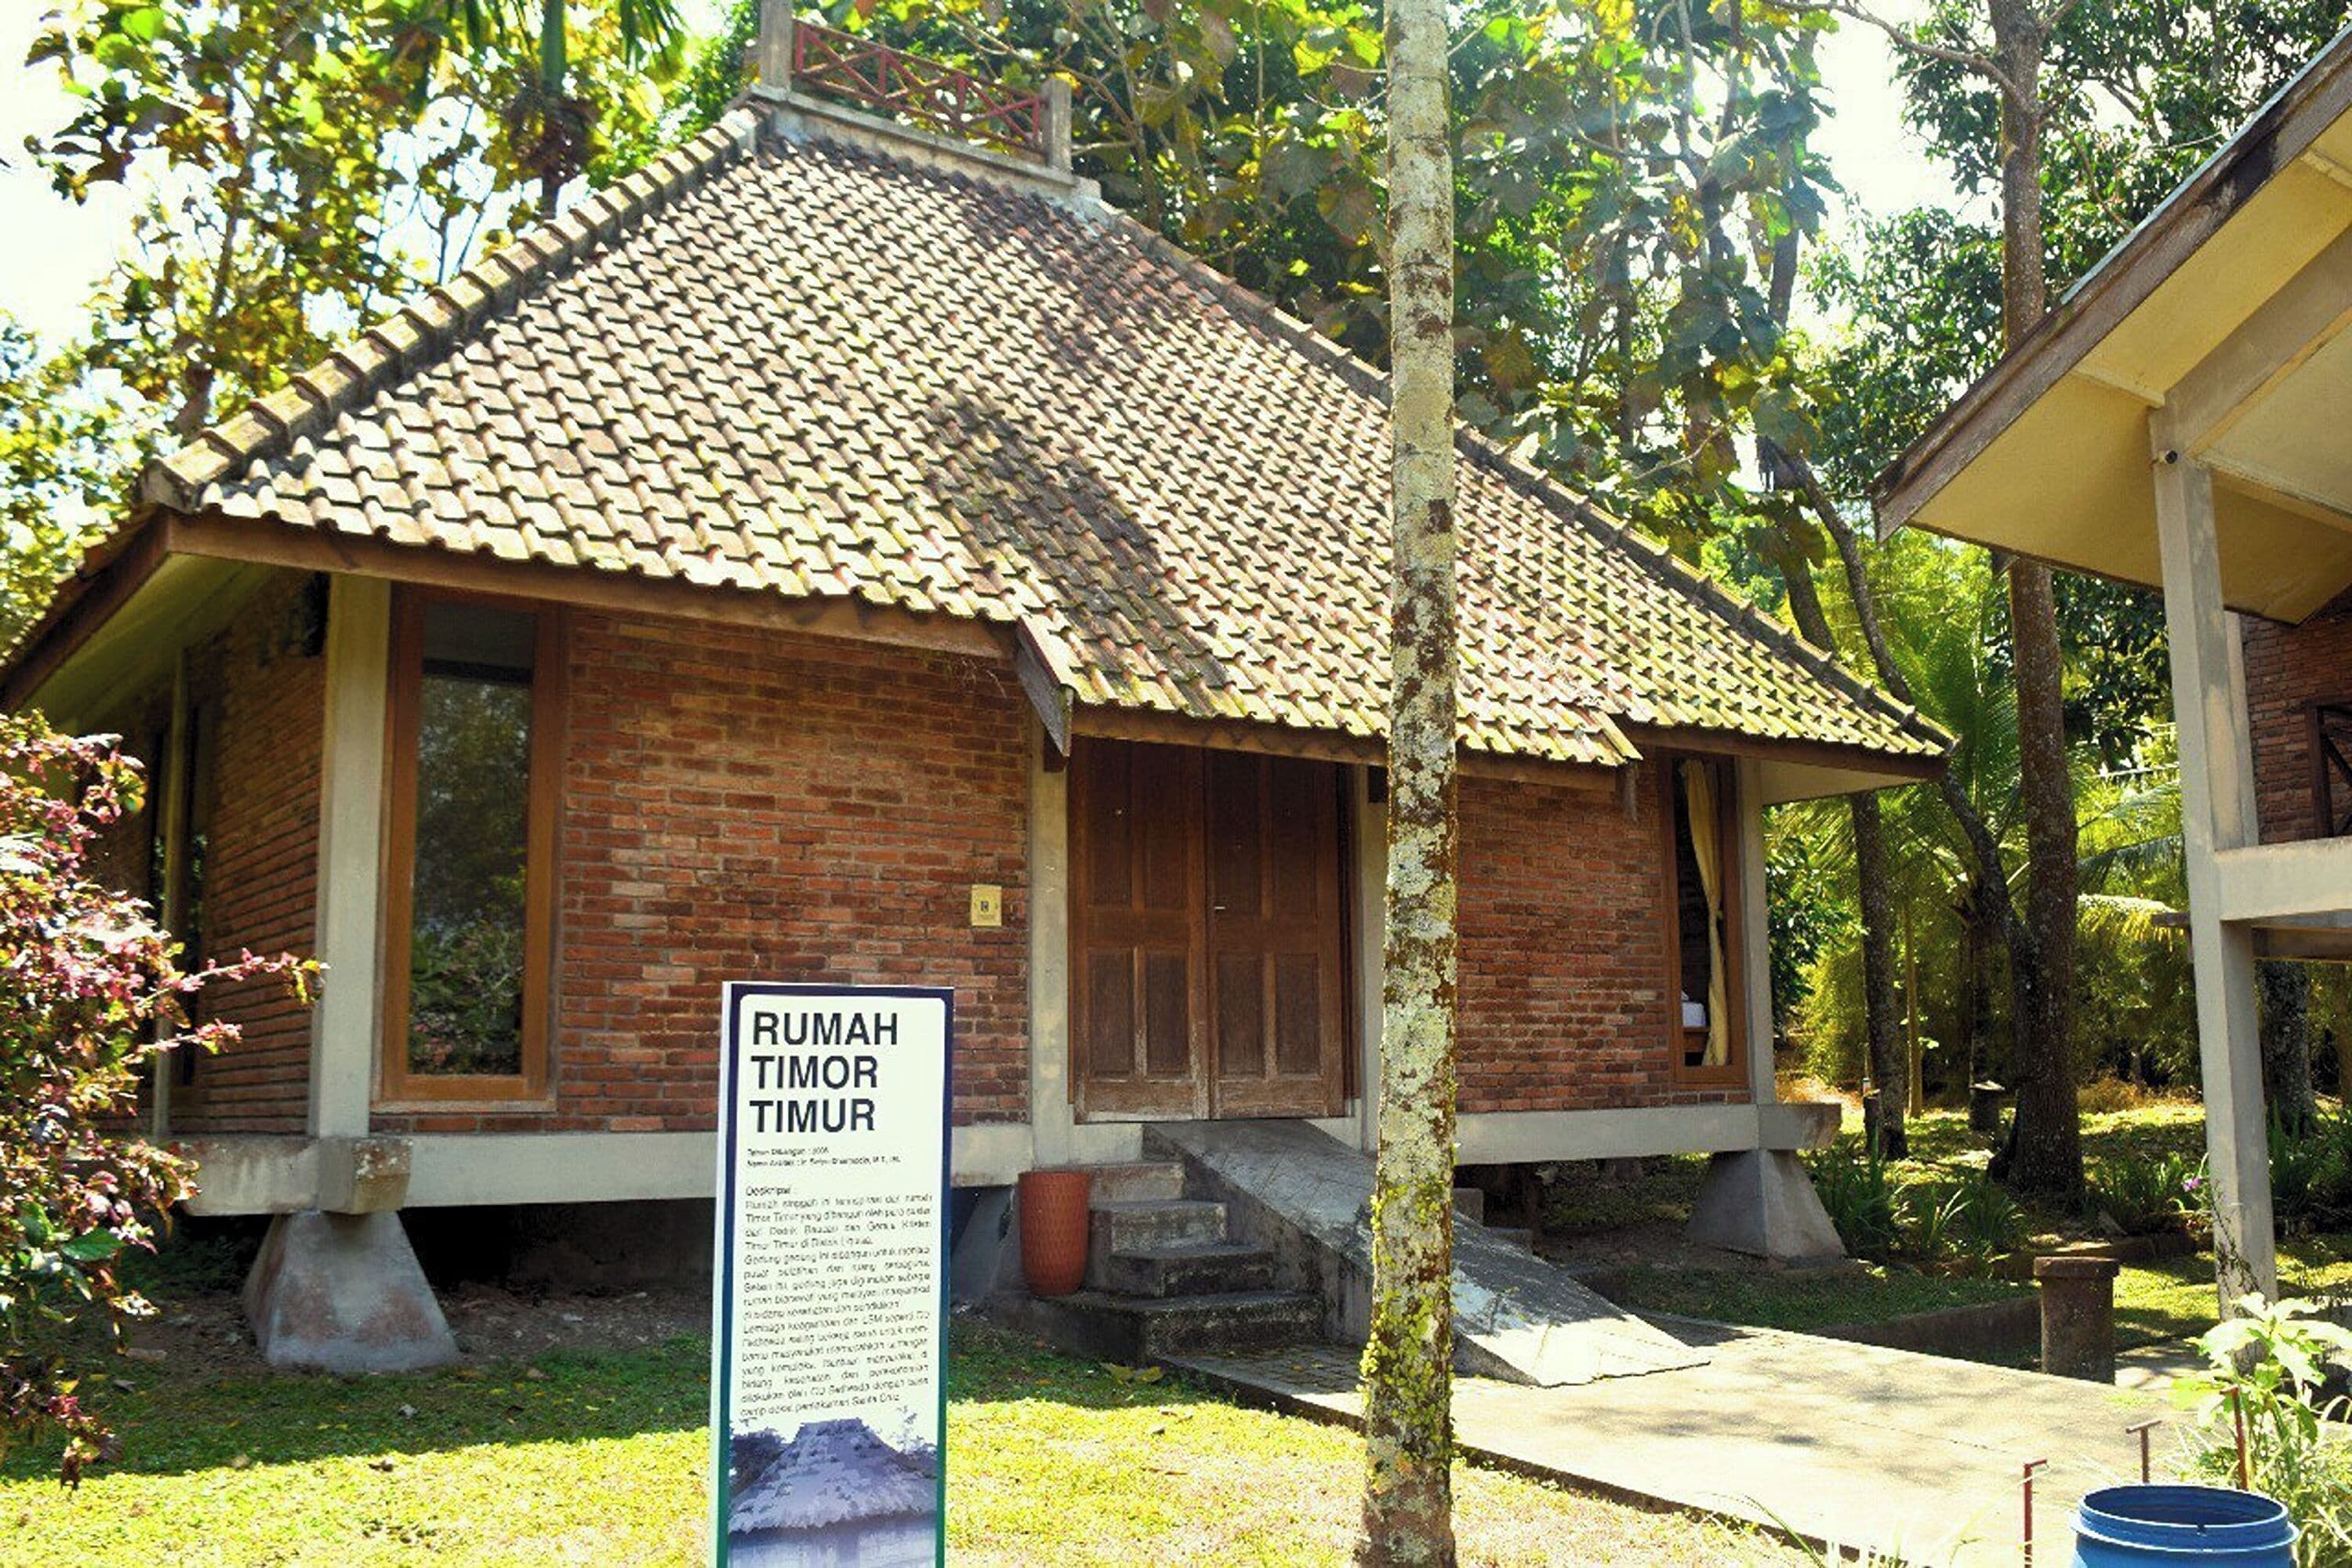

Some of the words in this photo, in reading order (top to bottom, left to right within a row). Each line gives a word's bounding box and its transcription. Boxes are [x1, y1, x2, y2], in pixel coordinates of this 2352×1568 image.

[753, 1011, 898, 1045] RUMAH
[750, 1055, 878, 1089] TIMOR
[749, 1098, 875, 1133] TIMUR
